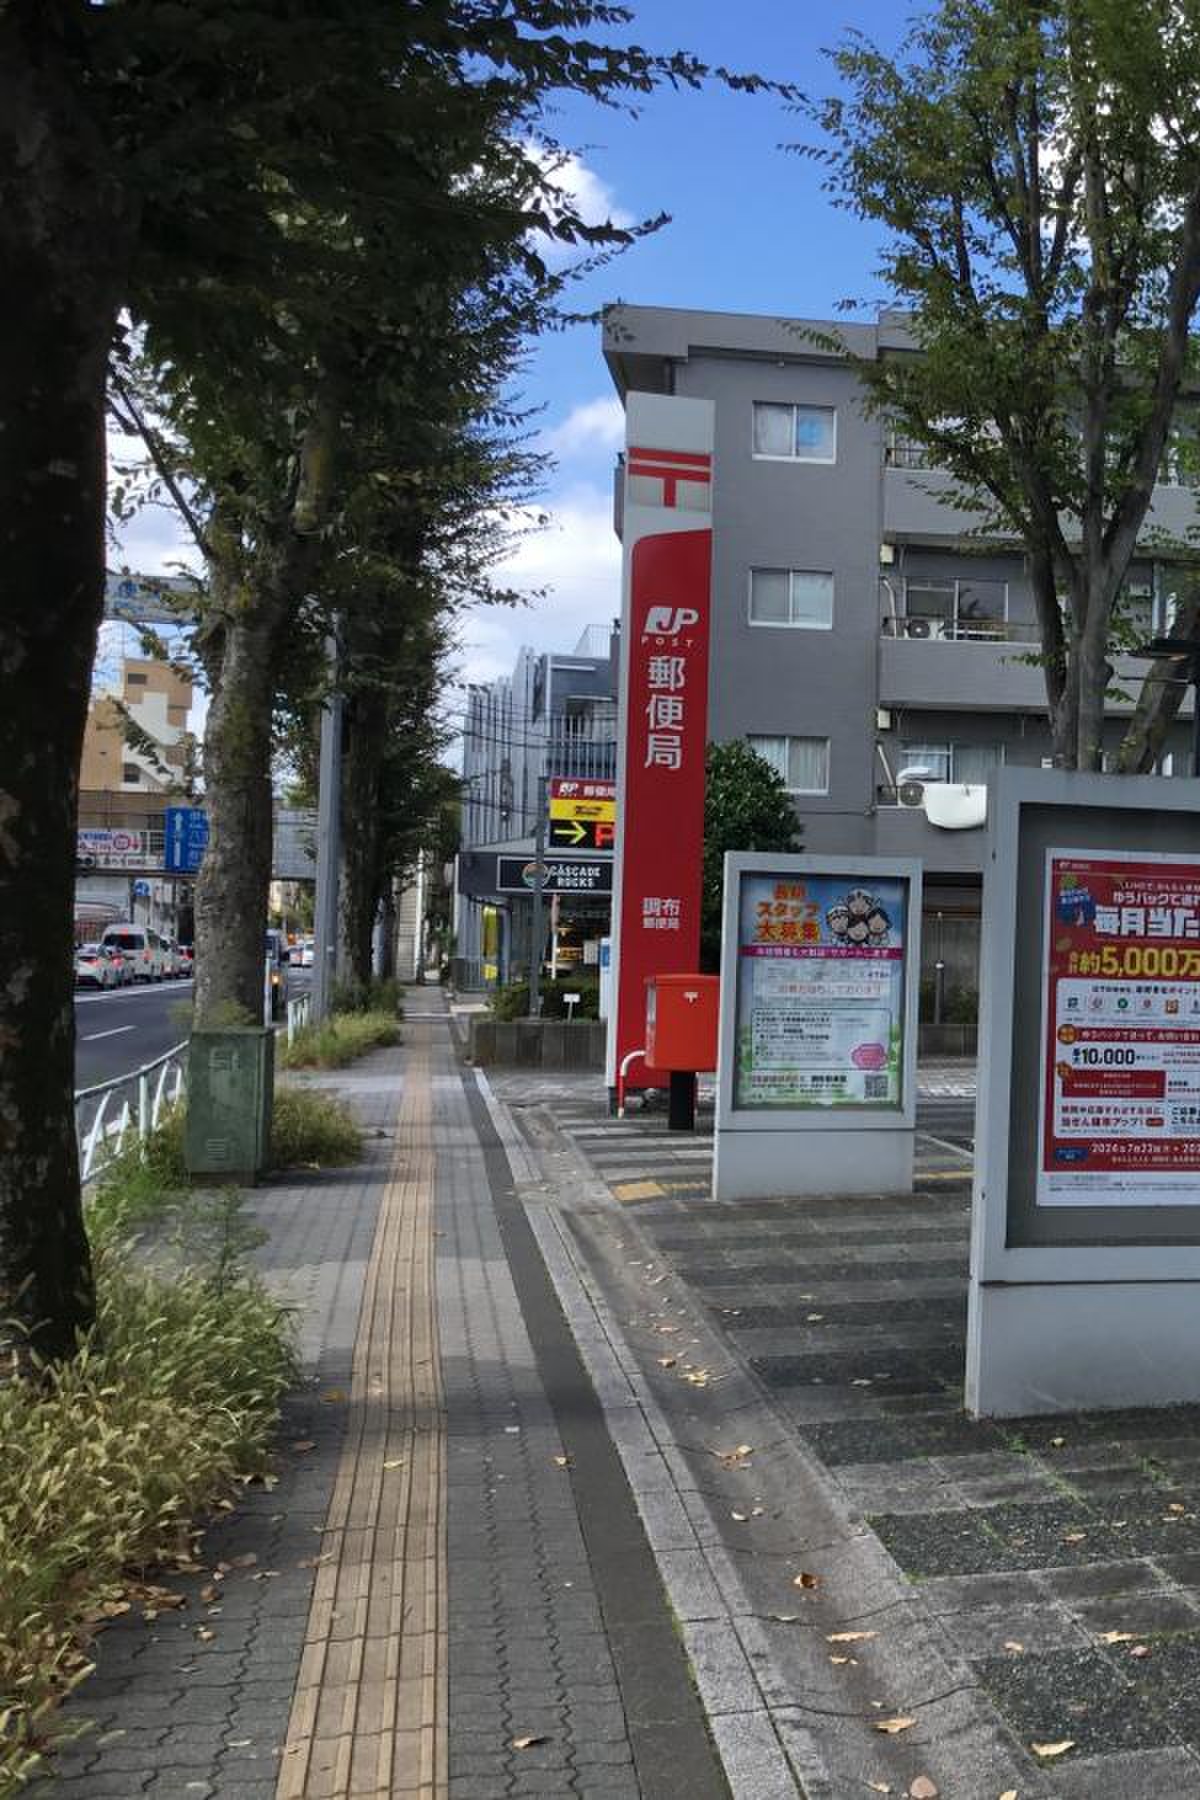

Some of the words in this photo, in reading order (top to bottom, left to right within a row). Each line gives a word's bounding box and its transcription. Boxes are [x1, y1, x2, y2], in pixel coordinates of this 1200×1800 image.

[641, 637, 694, 648] POST
[644, 655, 686, 770] 郵便局
[556, 878, 596, 888] ROCKS
[642, 897, 681, 916] 調布
[755, 902, 820, 918] スタッフ
[1082, 1048, 1136, 1065] 10,000
